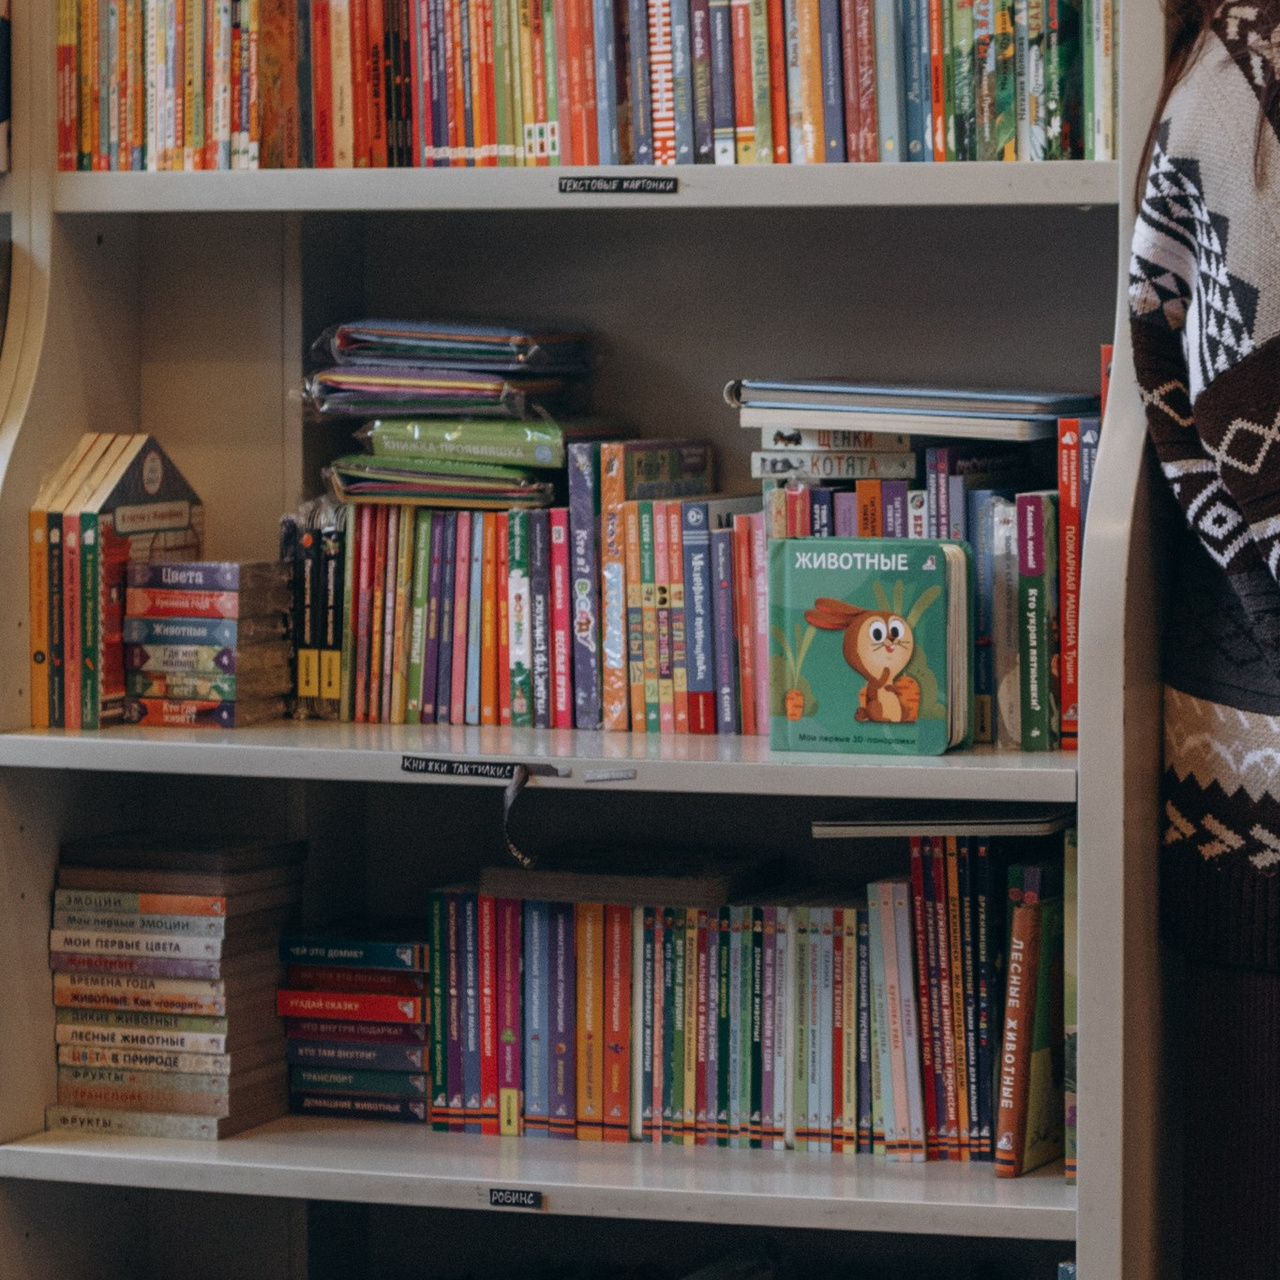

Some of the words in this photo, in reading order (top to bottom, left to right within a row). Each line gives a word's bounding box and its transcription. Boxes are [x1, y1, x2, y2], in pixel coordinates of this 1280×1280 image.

[1102, 2, 1111, 29] ЛЮБИТ
[1016, 35, 1026, 77] Волкова
[1102, 31, 1111, 58] МАМА
[1017, 80, 1026, 120] Наталия
[560, 178, 618, 193] ТЕКСТОВЫЕ
[622, 177, 674, 192] КАРТОНКИ
[382, 436, 435, 453] КНИЖКА
[438, 441, 526, 459] ПРОЯВЛЯШКА
[817, 429, 876, 447] ЩЕНКИ
[809, 454, 877, 476] КОТЯТА
[575, 528, 589, 556] Кто
[642, 513, 651, 543] CLEVER
[576, 557, 589, 574] я?
[794, 551, 908, 571] ЖИВОТНЫЕ
[1064, 525, 1075, 590] ПОЖАРНАЯ
[161, 566, 204, 585] Цвета
[691, 552, 707, 614] Маленькие
[1027, 588, 1037, 609] Кто
[153, 621, 207, 637] Животные
[512, 591, 526, 646] ФОРМЫ
[533, 593, 547, 650] СПРЯТАЛСЯ
[1025, 611, 1038, 646] украл
[1065, 593, 1075, 645] МАШИНА
[408, 607, 425, 664] ЖИВОТНЫЕ
[628, 613, 642, 655] ВЕСЫ
[658, 610, 670, 673] БЛИЗНЕЦЫ
[672, 613, 686, 660] ТЕЛЕЦ
[534, 653, 547, 672] КТО
[692, 617, 708, 680] помощники
[1028, 648, 1040, 711] пятнышки?
[1064, 650, 1077, 684] Тушик
[534, 674, 547, 715] УГАДАЙ,
[555, 673, 567, 711] ПРЯТКИ
[798, 733, 816, 742] Мои
[818, 734, 850, 744] первые
[868, 737, 917, 745] панорамки
[403, 758, 447, 773] КНИЖКИ
[65, 893, 121, 906] ЭМОЦИИ
[66, 915, 90, 927] Мои
[93, 915, 135, 928] первые
[139, 918, 189, 931] ЭМОЦИИ
[62, 937, 91, 949] МОИ
[93, 937, 141, 951] ПЕРВЫЕ
[144, 939, 180, 952] ЦВЕТА
[644, 943, 653, 958] КАК
[66, 955, 134, 968] ЖИВОТНЫЕ
[752, 946, 762, 994] ДОМАШНИЕ
[833, 950, 842, 982] ЗВУКИ
[1005, 937, 1025, 1009] ЛЕСНЫЕ
[69, 975, 121, 988] ВРЕМЕНА
[124, 977, 155, 989] ГОДА
[643, 960, 653, 1025] РАЗГОВАРИВАЮТ
[939, 978, 950, 1006] ТАКИЕ
[71, 1011, 109, 1022] ДИКИЕ
[114, 1012, 179, 1026] ЖИВОТНЫЕ
[288, 999, 323, 1009] УГАДАЙ
[324, 1000, 360, 1011] СКАЗКУ
[832, 984, 842, 1029] ТЕХНИКИ
[902, 997, 914, 1040] ТЕРЕМОК
[751, 996, 761, 1043] ЖИВОТНЫЕ
[70, 1030, 115, 1044] ЛЕСНЫЕ
[119, 1032, 184, 1046] ЖИВОТНЫЕ
[643, 1027, 652, 1072] ЖИВОТНЫЕ
[940, 1007, 954, 1065] ИНТЕРЕСНЫЕ
[72, 1068, 124, 1082] ФРУКТЫ
[998, 1017, 1021, 1109] ЖИВОТНЫЕ
[301, 1072, 355, 1084] ТРАНСПОРТ
[302, 1098, 352, 1110] ДОМАШНИЕ
[352, 1100, 402, 1112] ЖИВОТНЫЕ
[944, 1066, 957, 1122] ПРОФЕССИИ
[59, 1115, 112, 1127] ФРУКТЫ
[491, 1190, 535, 1205] РОБИНС
